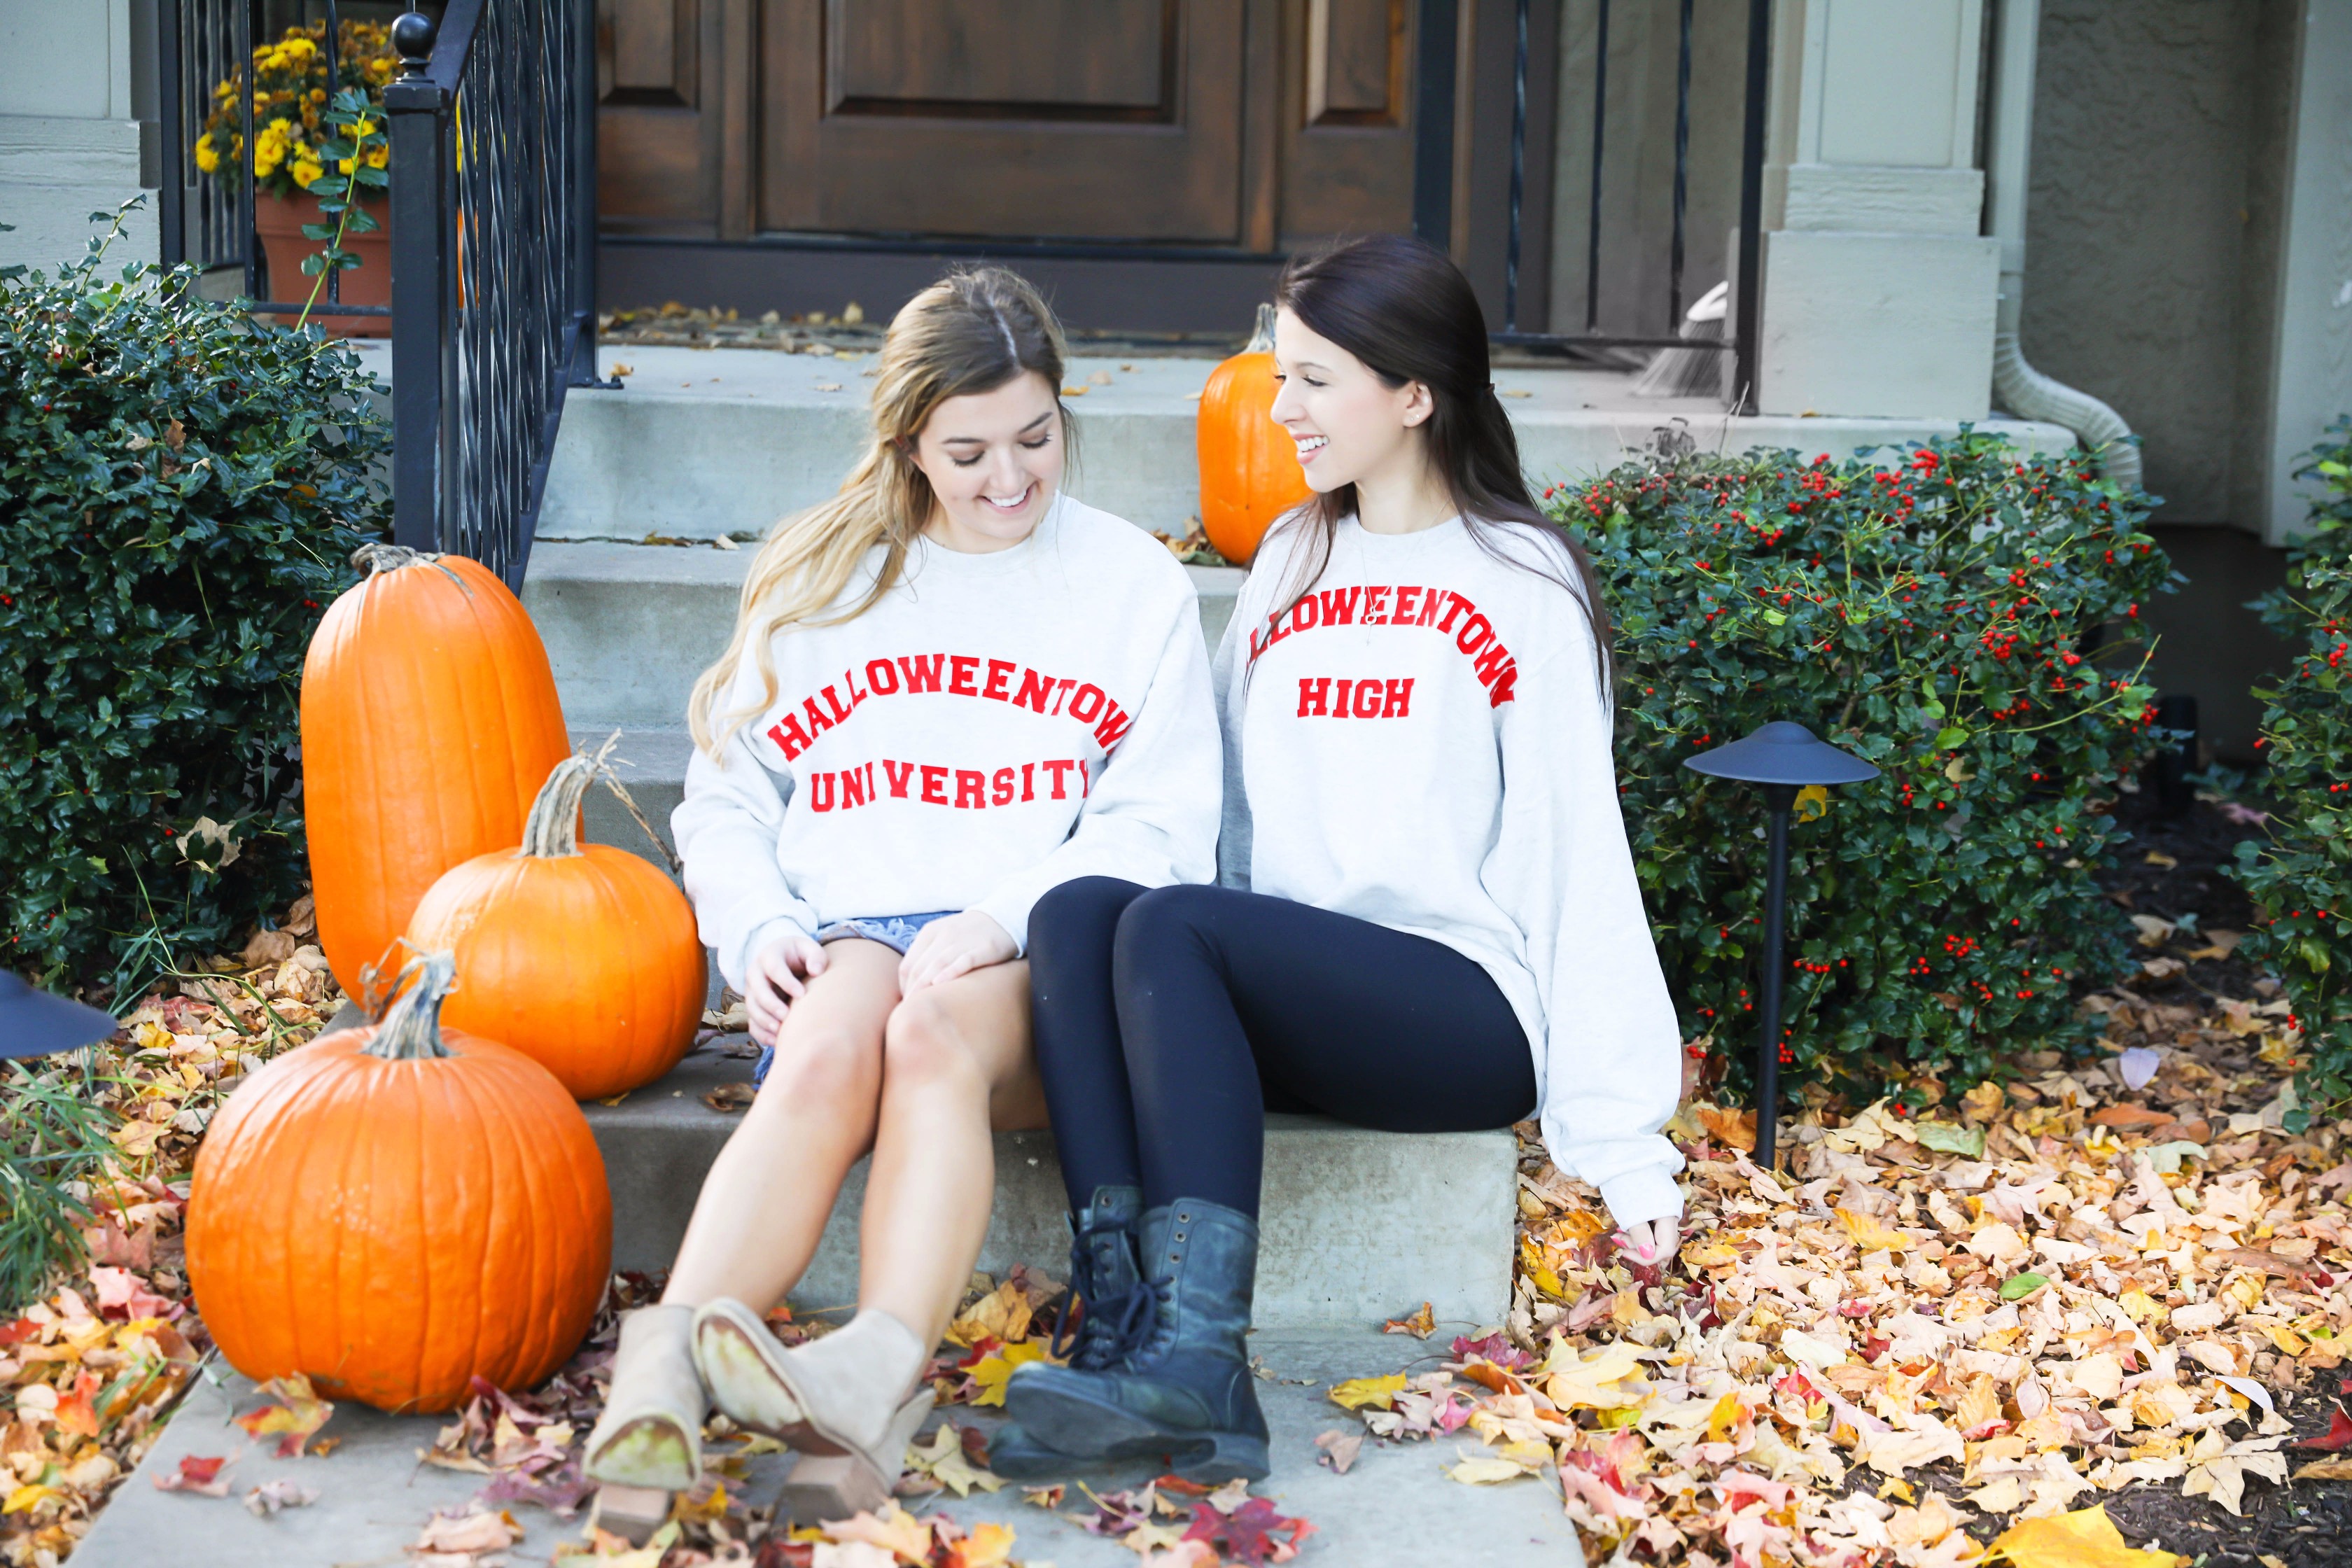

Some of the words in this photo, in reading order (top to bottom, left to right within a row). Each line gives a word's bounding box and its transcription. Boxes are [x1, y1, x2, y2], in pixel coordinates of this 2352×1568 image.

[1247, 585, 1518, 709] LLOWEENTOWN
[1297, 677, 1415, 718] HIGH
[766, 652, 1134, 762] HALLOWEENTOW
